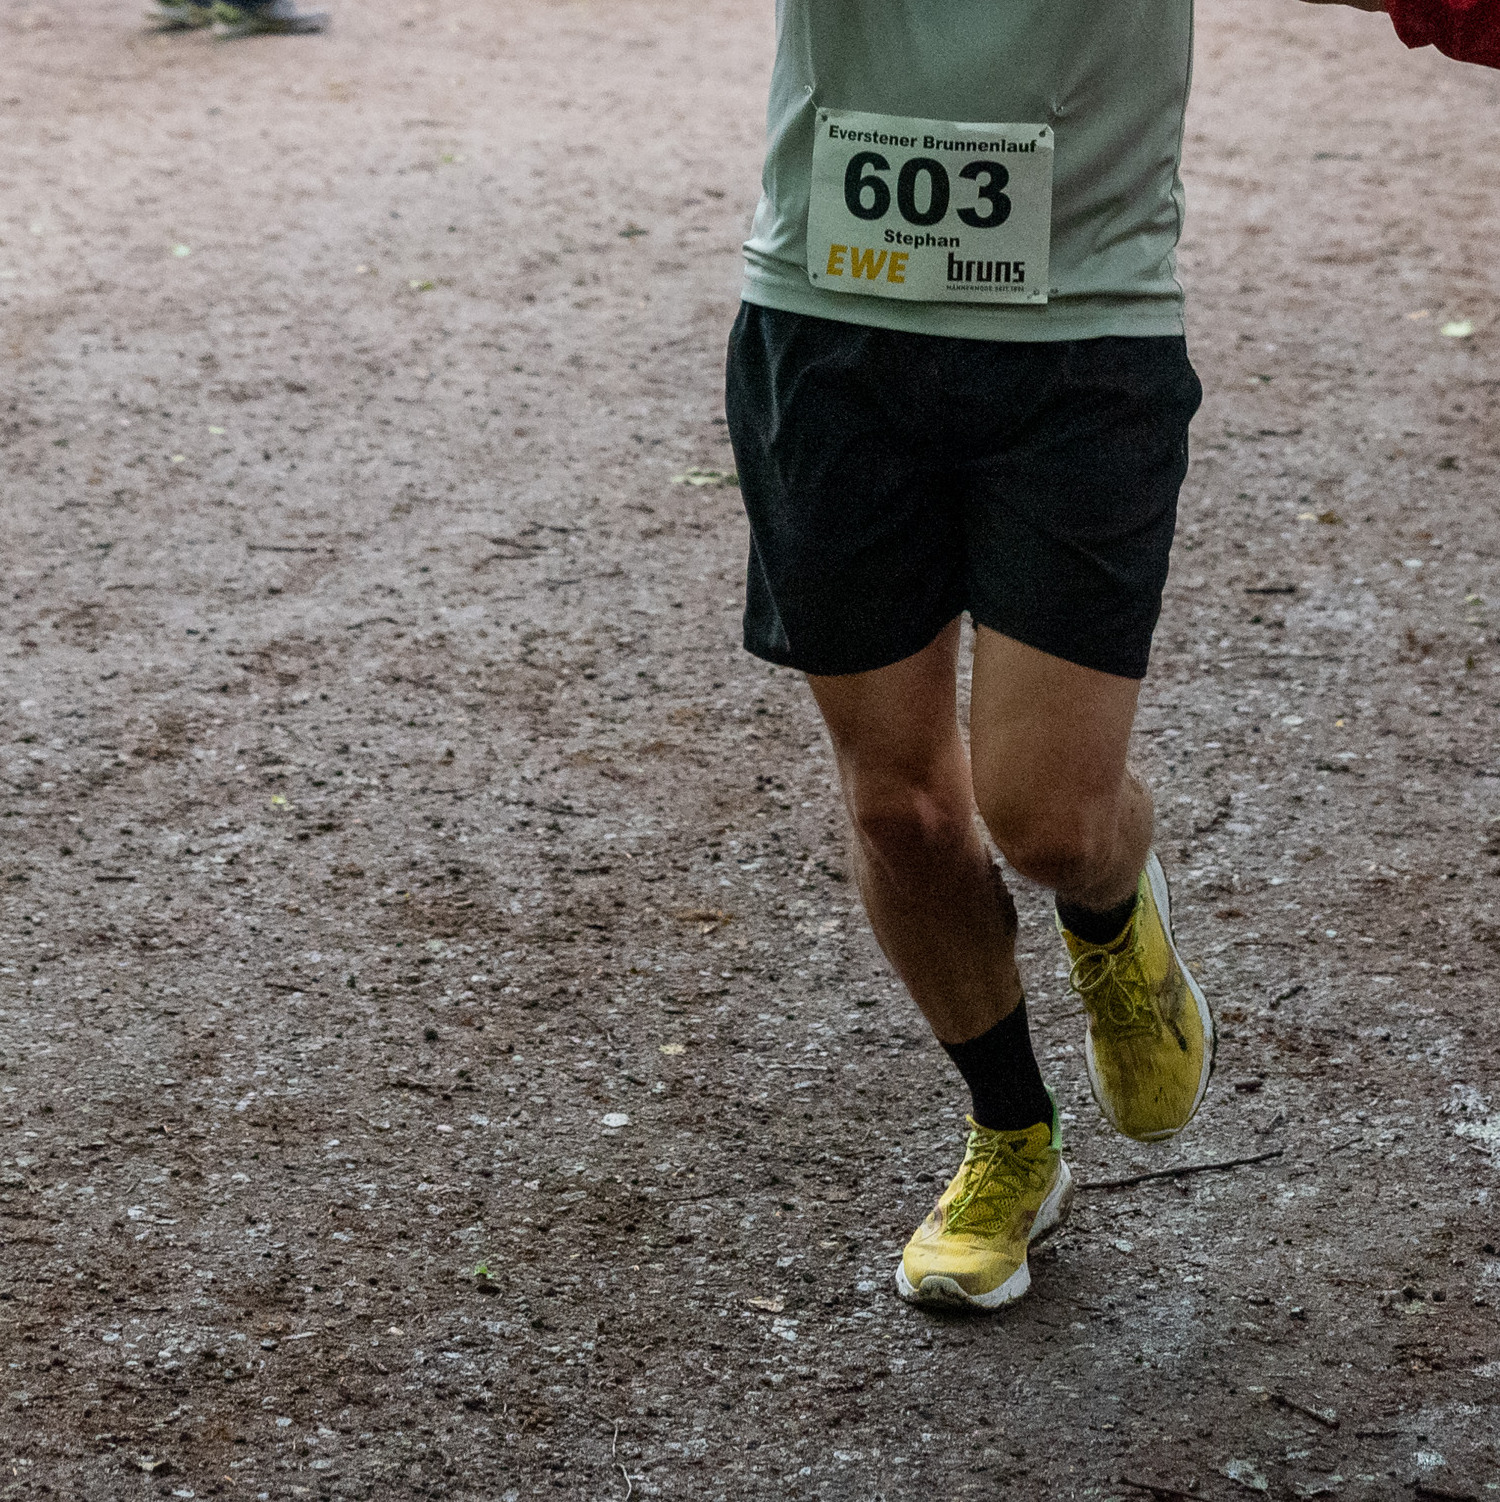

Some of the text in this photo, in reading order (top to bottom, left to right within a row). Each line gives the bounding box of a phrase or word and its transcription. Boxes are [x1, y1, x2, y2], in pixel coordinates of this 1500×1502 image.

[828, 124, 1037, 153] Everstener Brunnenlauf
[844, 151, 1012, 229] 603
[883, 229, 961, 249] Stephan
[826, 244, 909, 284] EWE
[946, 252, 1026, 283] bruns
